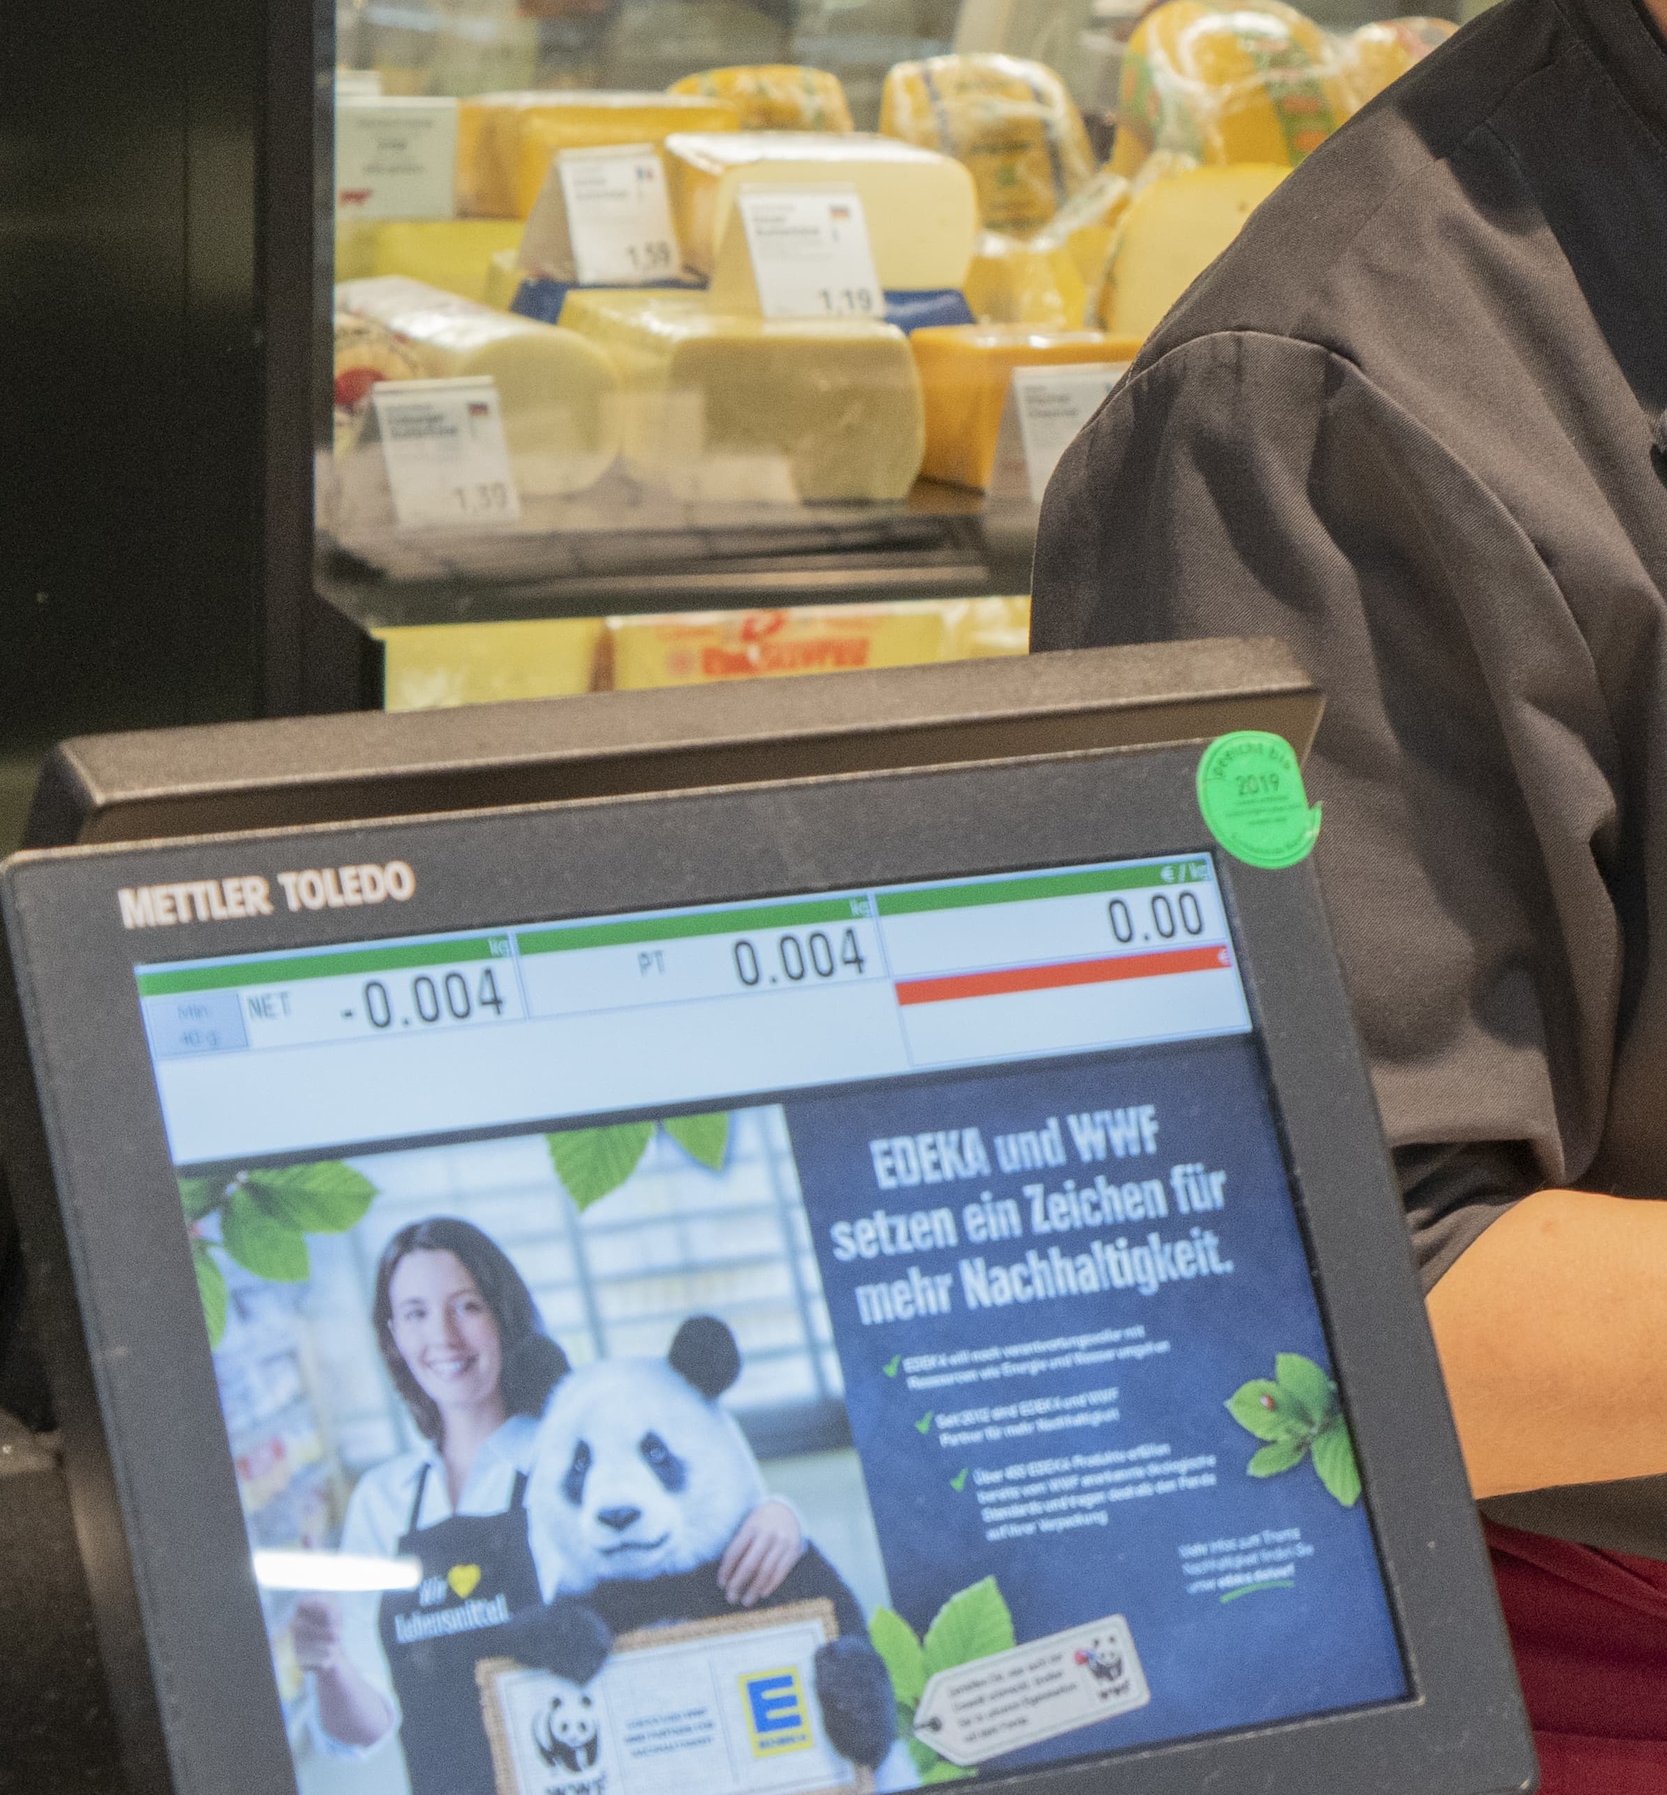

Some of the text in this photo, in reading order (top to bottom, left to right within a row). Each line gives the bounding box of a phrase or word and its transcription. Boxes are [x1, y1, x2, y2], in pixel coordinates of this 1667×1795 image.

[1235, 773, 1281, 796] 2019
[117, 860, 416, 931] METTLER TOLEDO
[1107, 891, 1204, 944] 0.00
[637, 927, 867, 988] PT 0.004
[247, 967, 506, 1030] NET -0.004
[870, 1104, 1160, 1190] EDEKA und WWF
[830, 1163, 1228, 1262] setzen ein Zeichen für
[855, 1227, 1235, 1325] mehr Nachhaltigkeit.
[1018, 1396, 1061, 1416] EDEKA
[1088, 1386, 1119, 1406] WWF
[938, 1429, 984, 1448] Partner
[745, 1674, 803, 1734] E
